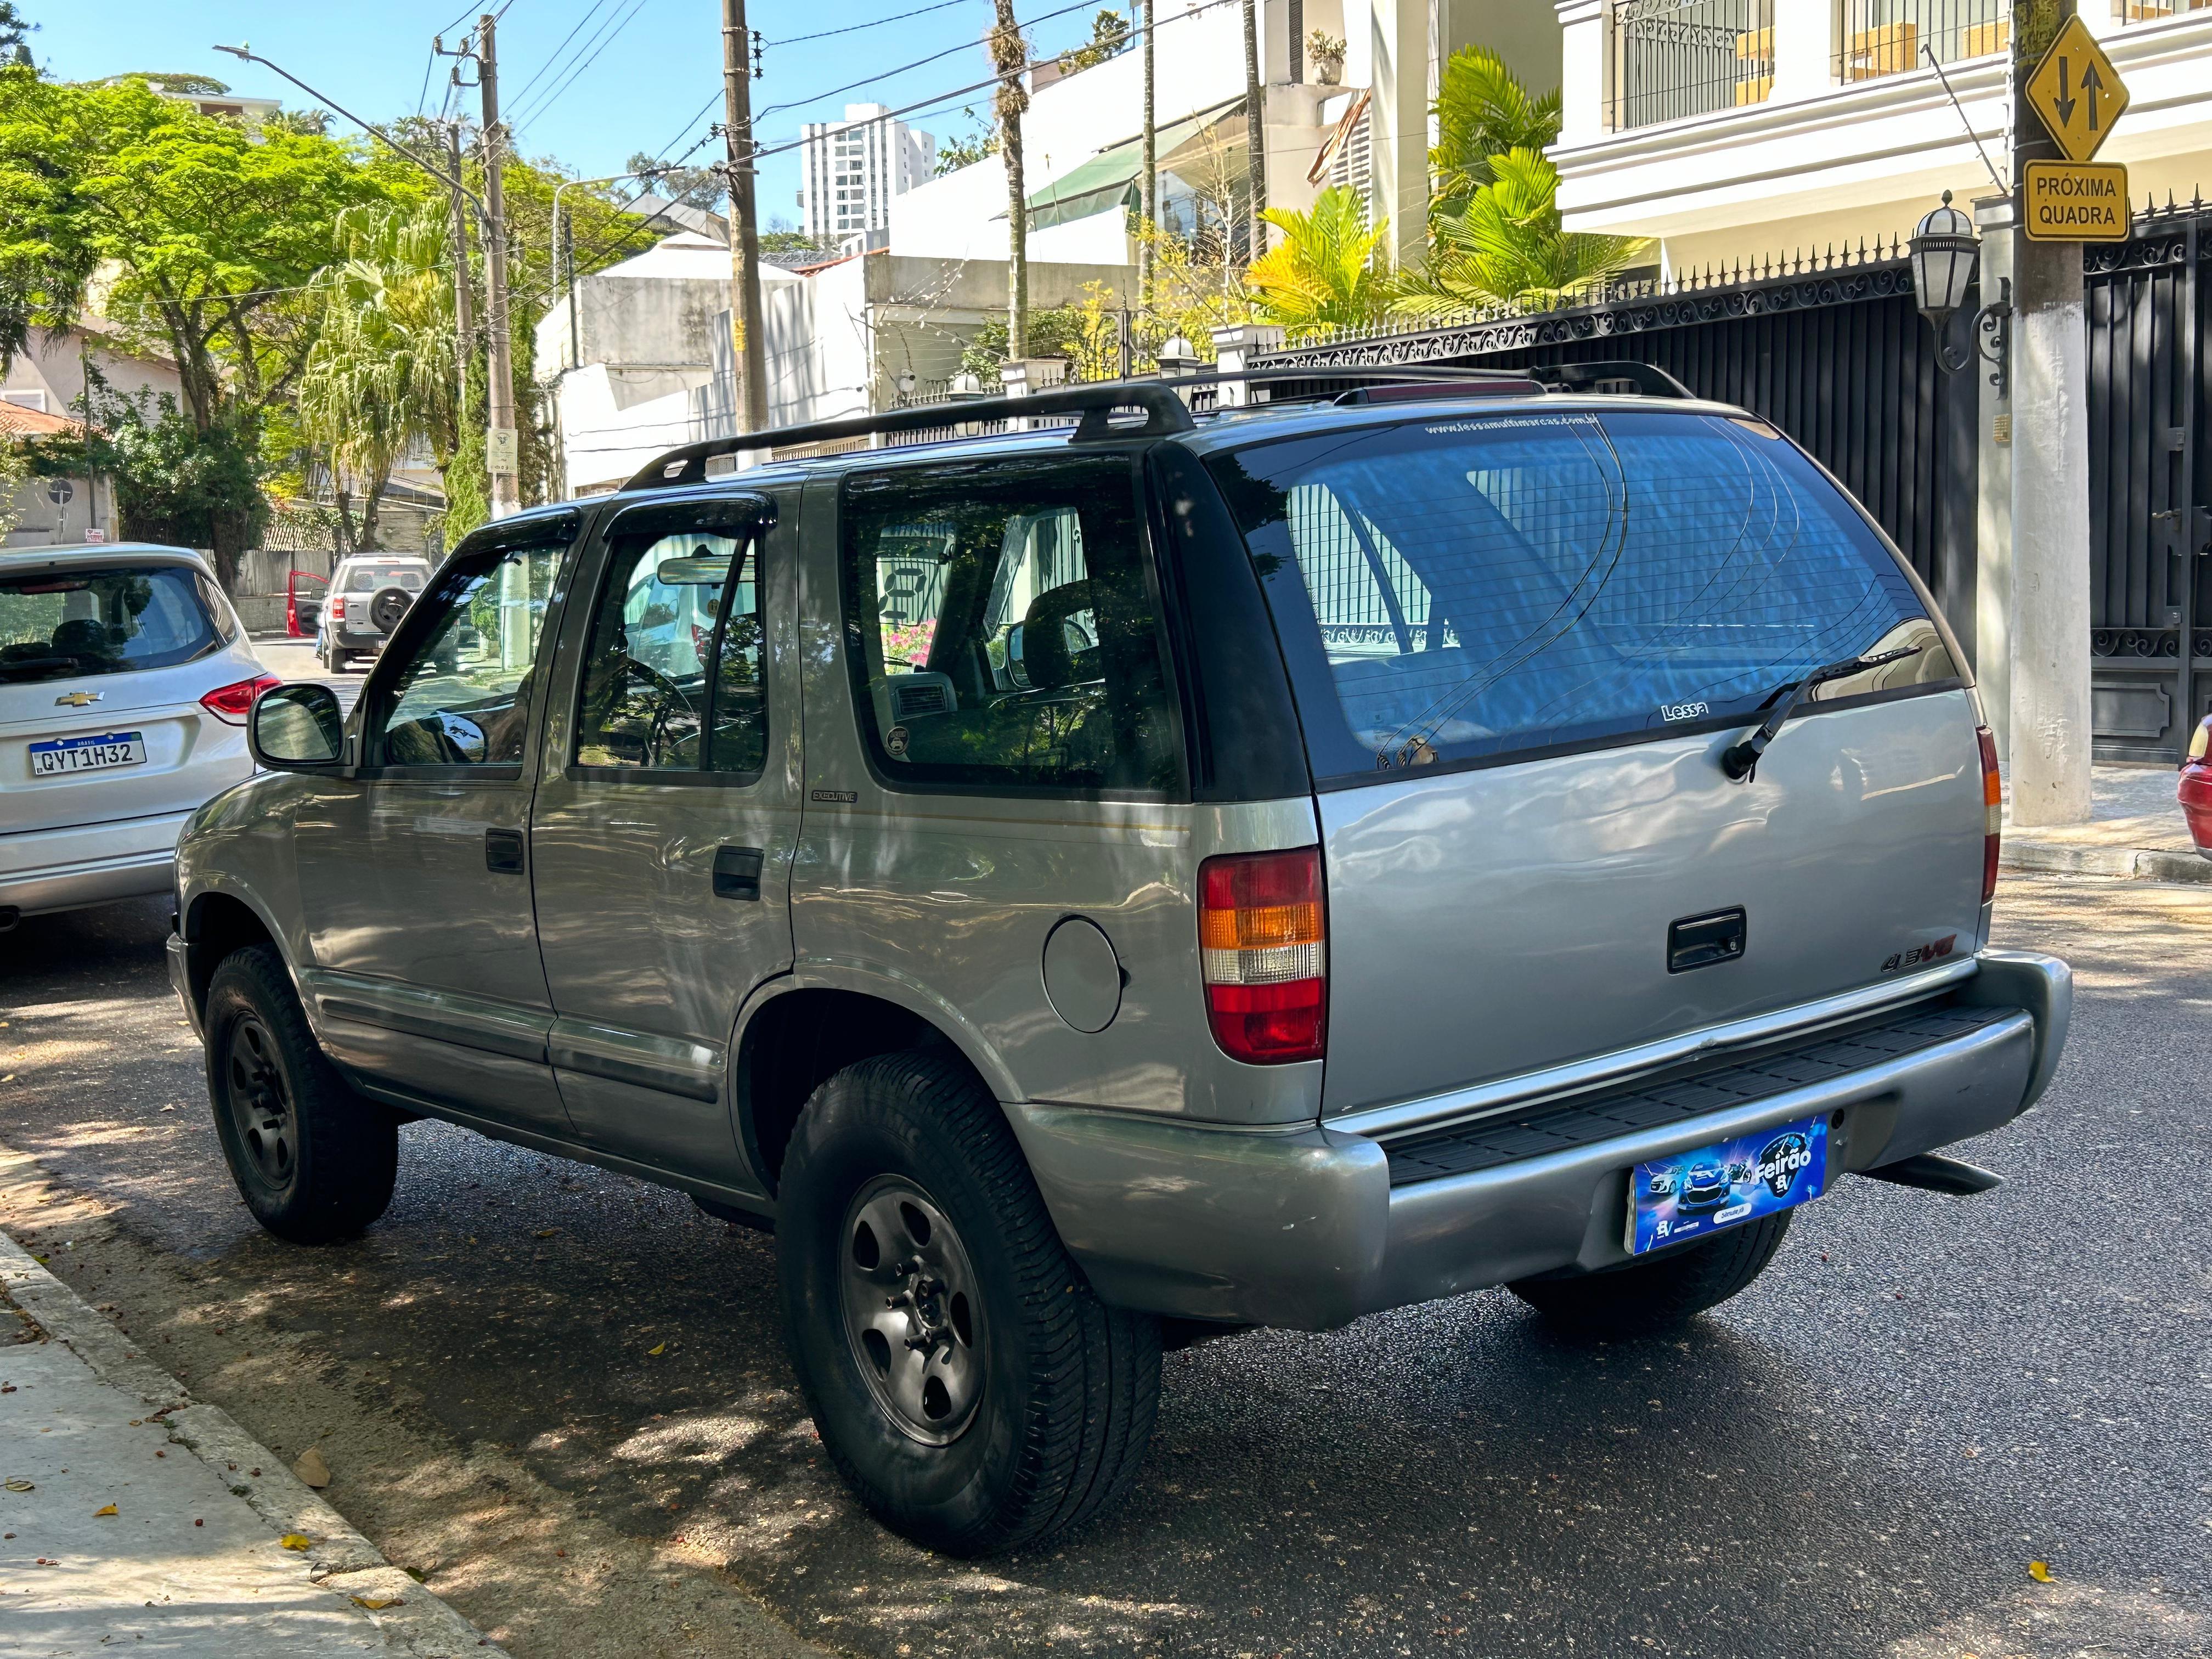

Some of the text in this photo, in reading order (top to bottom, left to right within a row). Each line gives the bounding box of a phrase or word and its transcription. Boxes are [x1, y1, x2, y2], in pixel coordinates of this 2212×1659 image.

[2037, 172, 2117, 196] PRÓXIMA
[2039, 205, 2115, 224] QUADRA
[1425, 413, 1598, 434] www.lessamultimarcas.com.br
[1661, 702, 1709, 721] Lessa
[42, 743, 133, 771] QYT1H32
[812, 791, 855, 801] EXECUTIVE
[1755, 1148, 1811, 1184] Feirão
